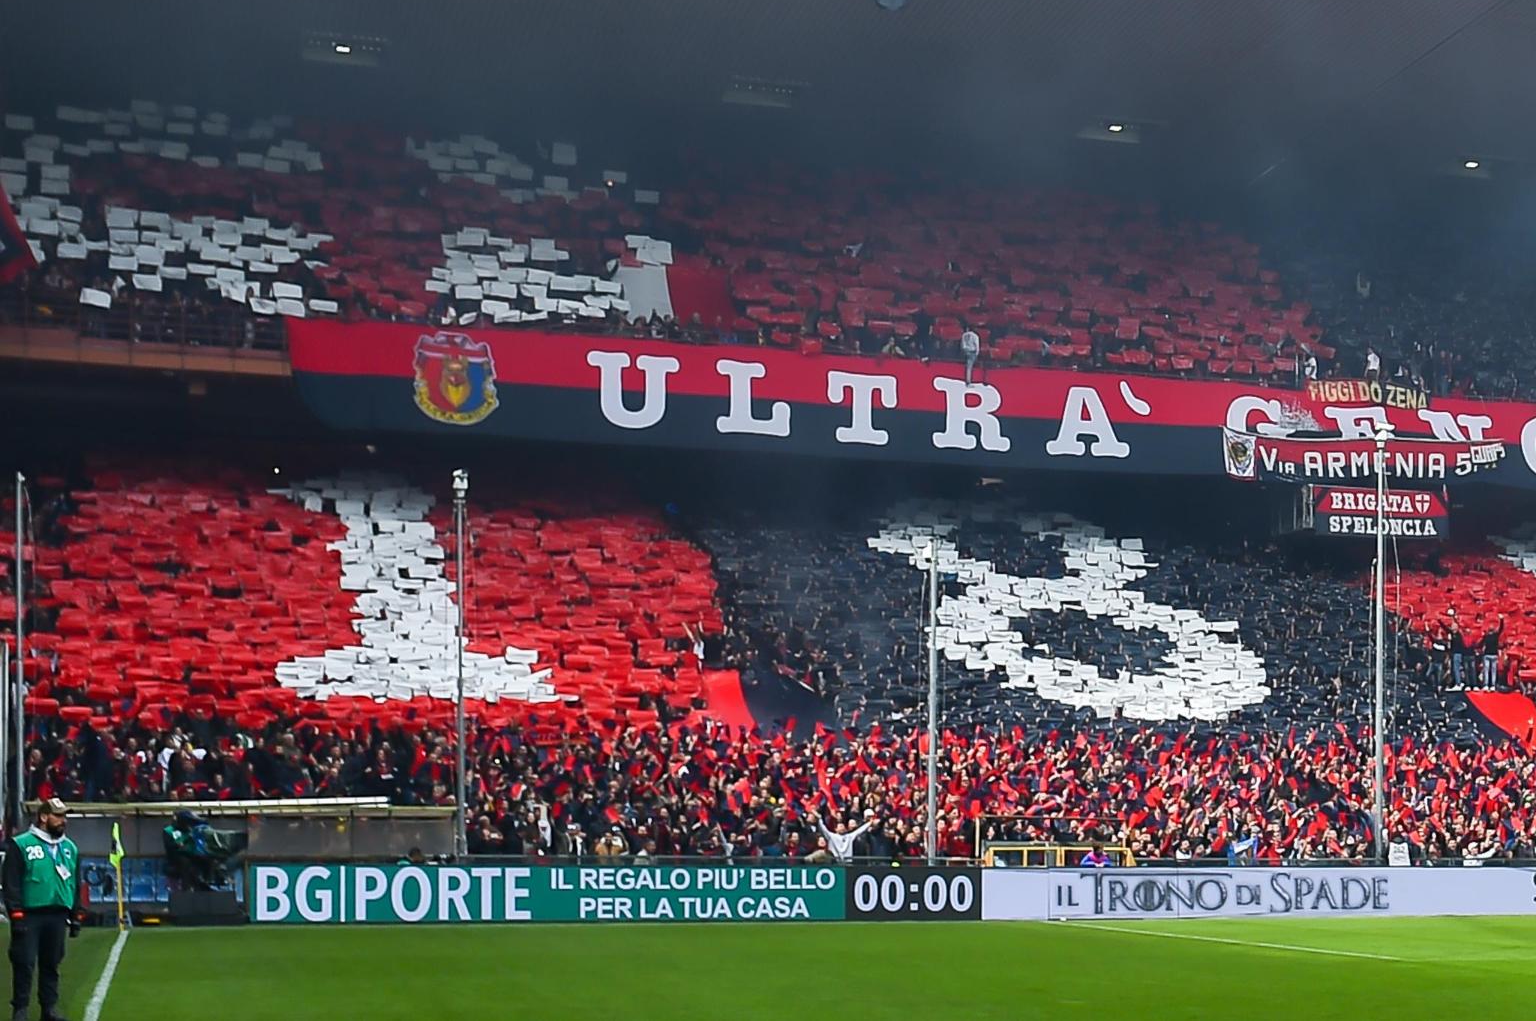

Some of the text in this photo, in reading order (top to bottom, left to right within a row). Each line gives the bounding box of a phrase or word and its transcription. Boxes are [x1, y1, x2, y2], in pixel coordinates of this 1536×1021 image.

[1386, 384, 1428, 409] ZENA
[1303, 451, 1446, 478] ARMENIA
[1330, 492, 1414, 513] BRIGATA
[1329, 515, 1437, 536] SPELONCIA
[551, 868, 573, 890] IL
[580, 868, 693, 890] REGALO
[751, 868, 835, 890] BELLO
[256, 865, 532, 922] BG PORTE
[854, 874, 974, 912] 00:00
[1057, 871, 1389, 914] IL TRONO DI SPADE
[579, 897, 810, 919] PER LA TUA CASA
